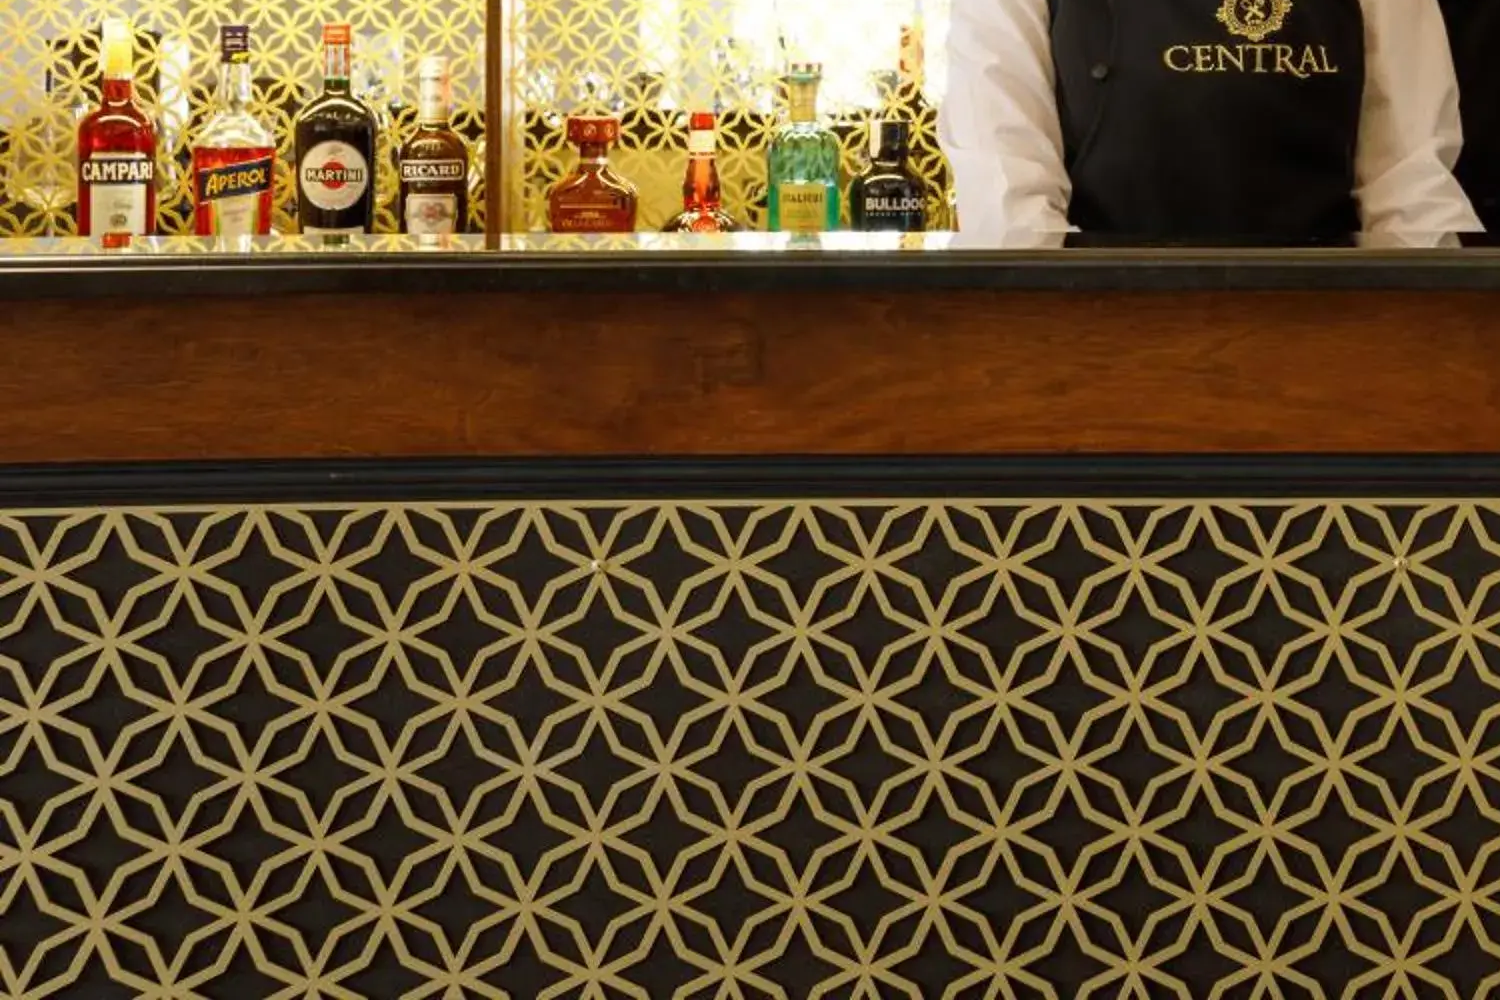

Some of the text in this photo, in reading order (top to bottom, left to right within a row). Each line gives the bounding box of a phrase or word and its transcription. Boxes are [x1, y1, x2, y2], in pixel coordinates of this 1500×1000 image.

[1163, 44, 1339, 79] CENTRAL
[82, 161, 153, 181] CAMPARI
[305, 167, 363, 183] MARTINI
[403, 165, 460, 177] RICARD
[205, 168, 266, 197] APEROL
